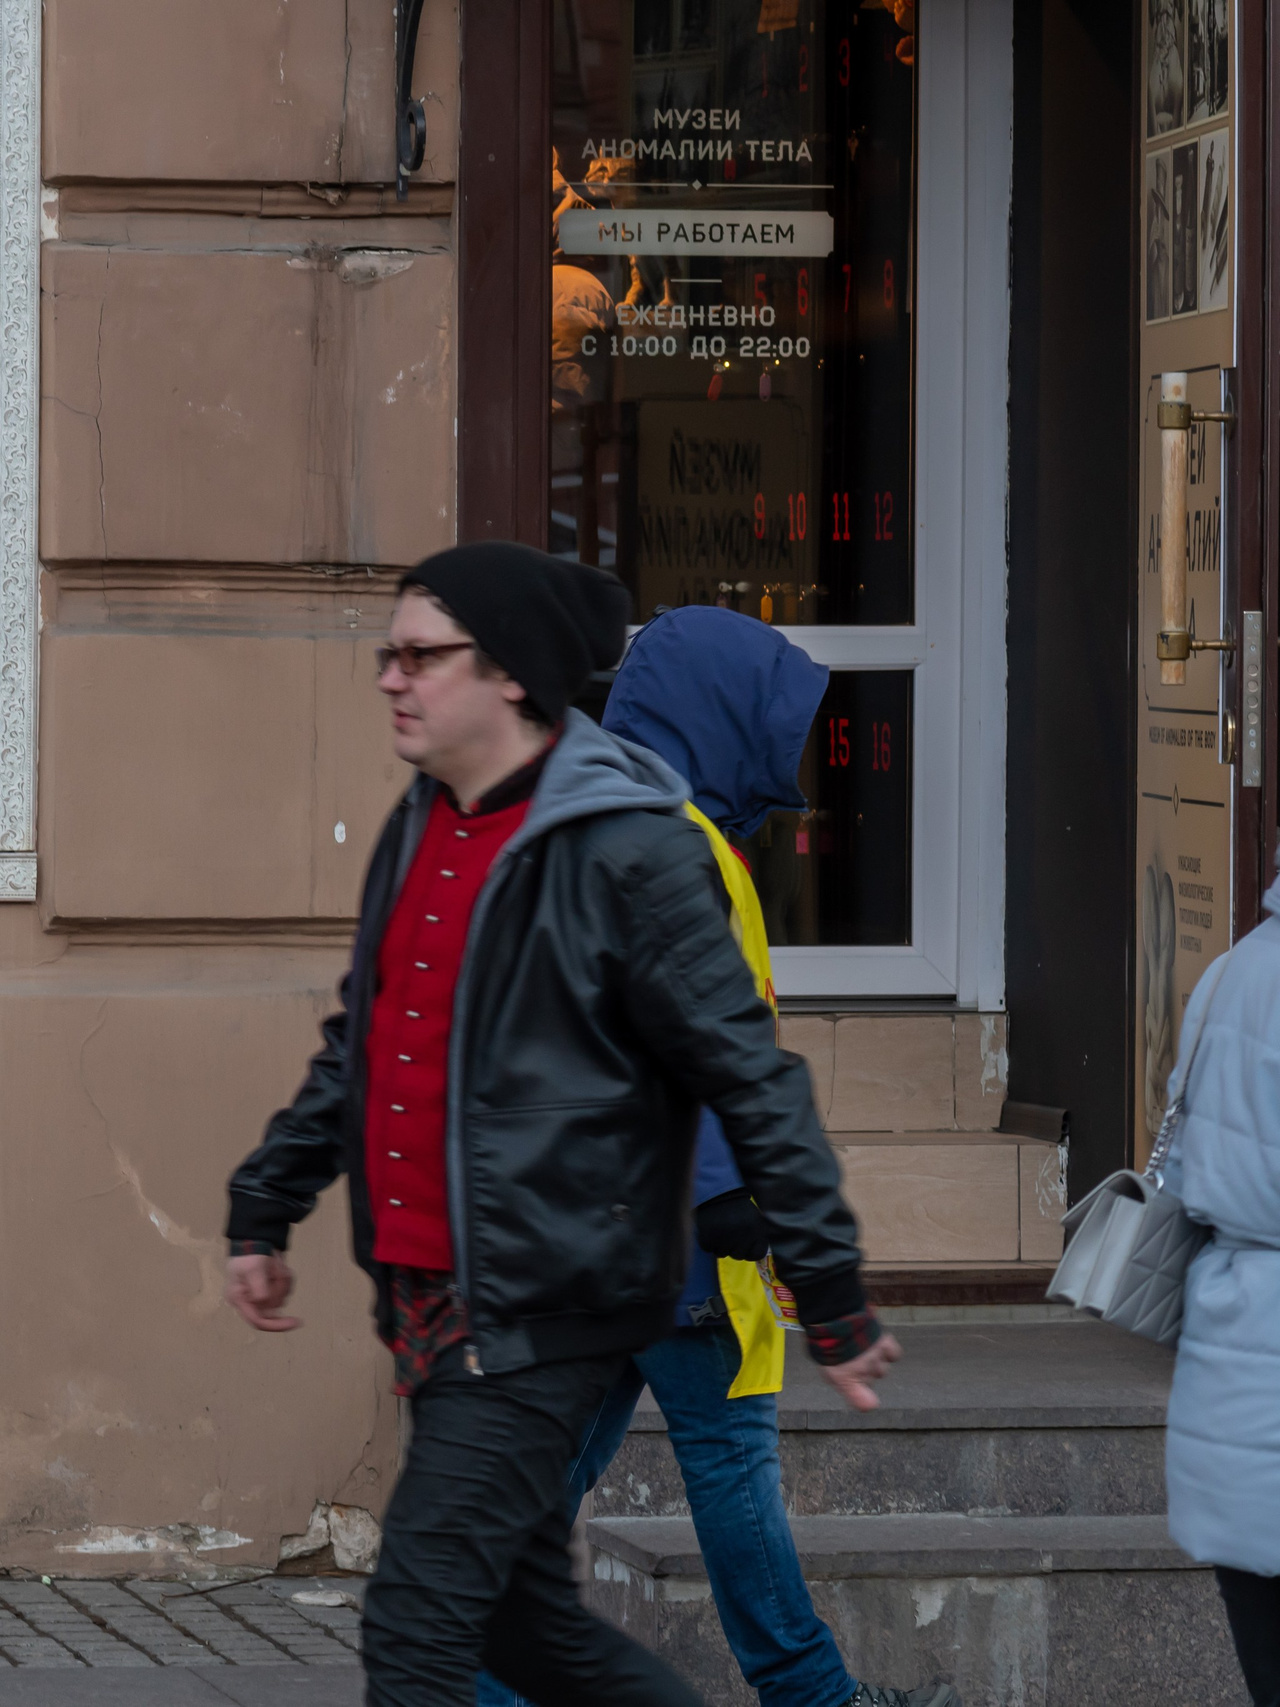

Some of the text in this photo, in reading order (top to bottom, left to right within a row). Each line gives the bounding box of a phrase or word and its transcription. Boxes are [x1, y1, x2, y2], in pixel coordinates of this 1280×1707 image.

[837, 37, 851, 87] 3
[745, 140, 813, 162] ТЕЛА
[597, 221, 795, 244] МЫ РАБОТАЕМ
[796, 267, 809, 316] 6
[841, 263, 852, 313] 7
[883, 259, 895, 309] 8
[615, 304, 776, 329] ЕЖЕДНЕВНО
[580, 335, 811, 360] С 10:00 ДО 22:00
[753, 491, 894, 541] 9 10 11 12
[828, 718, 892, 772] 15 16
